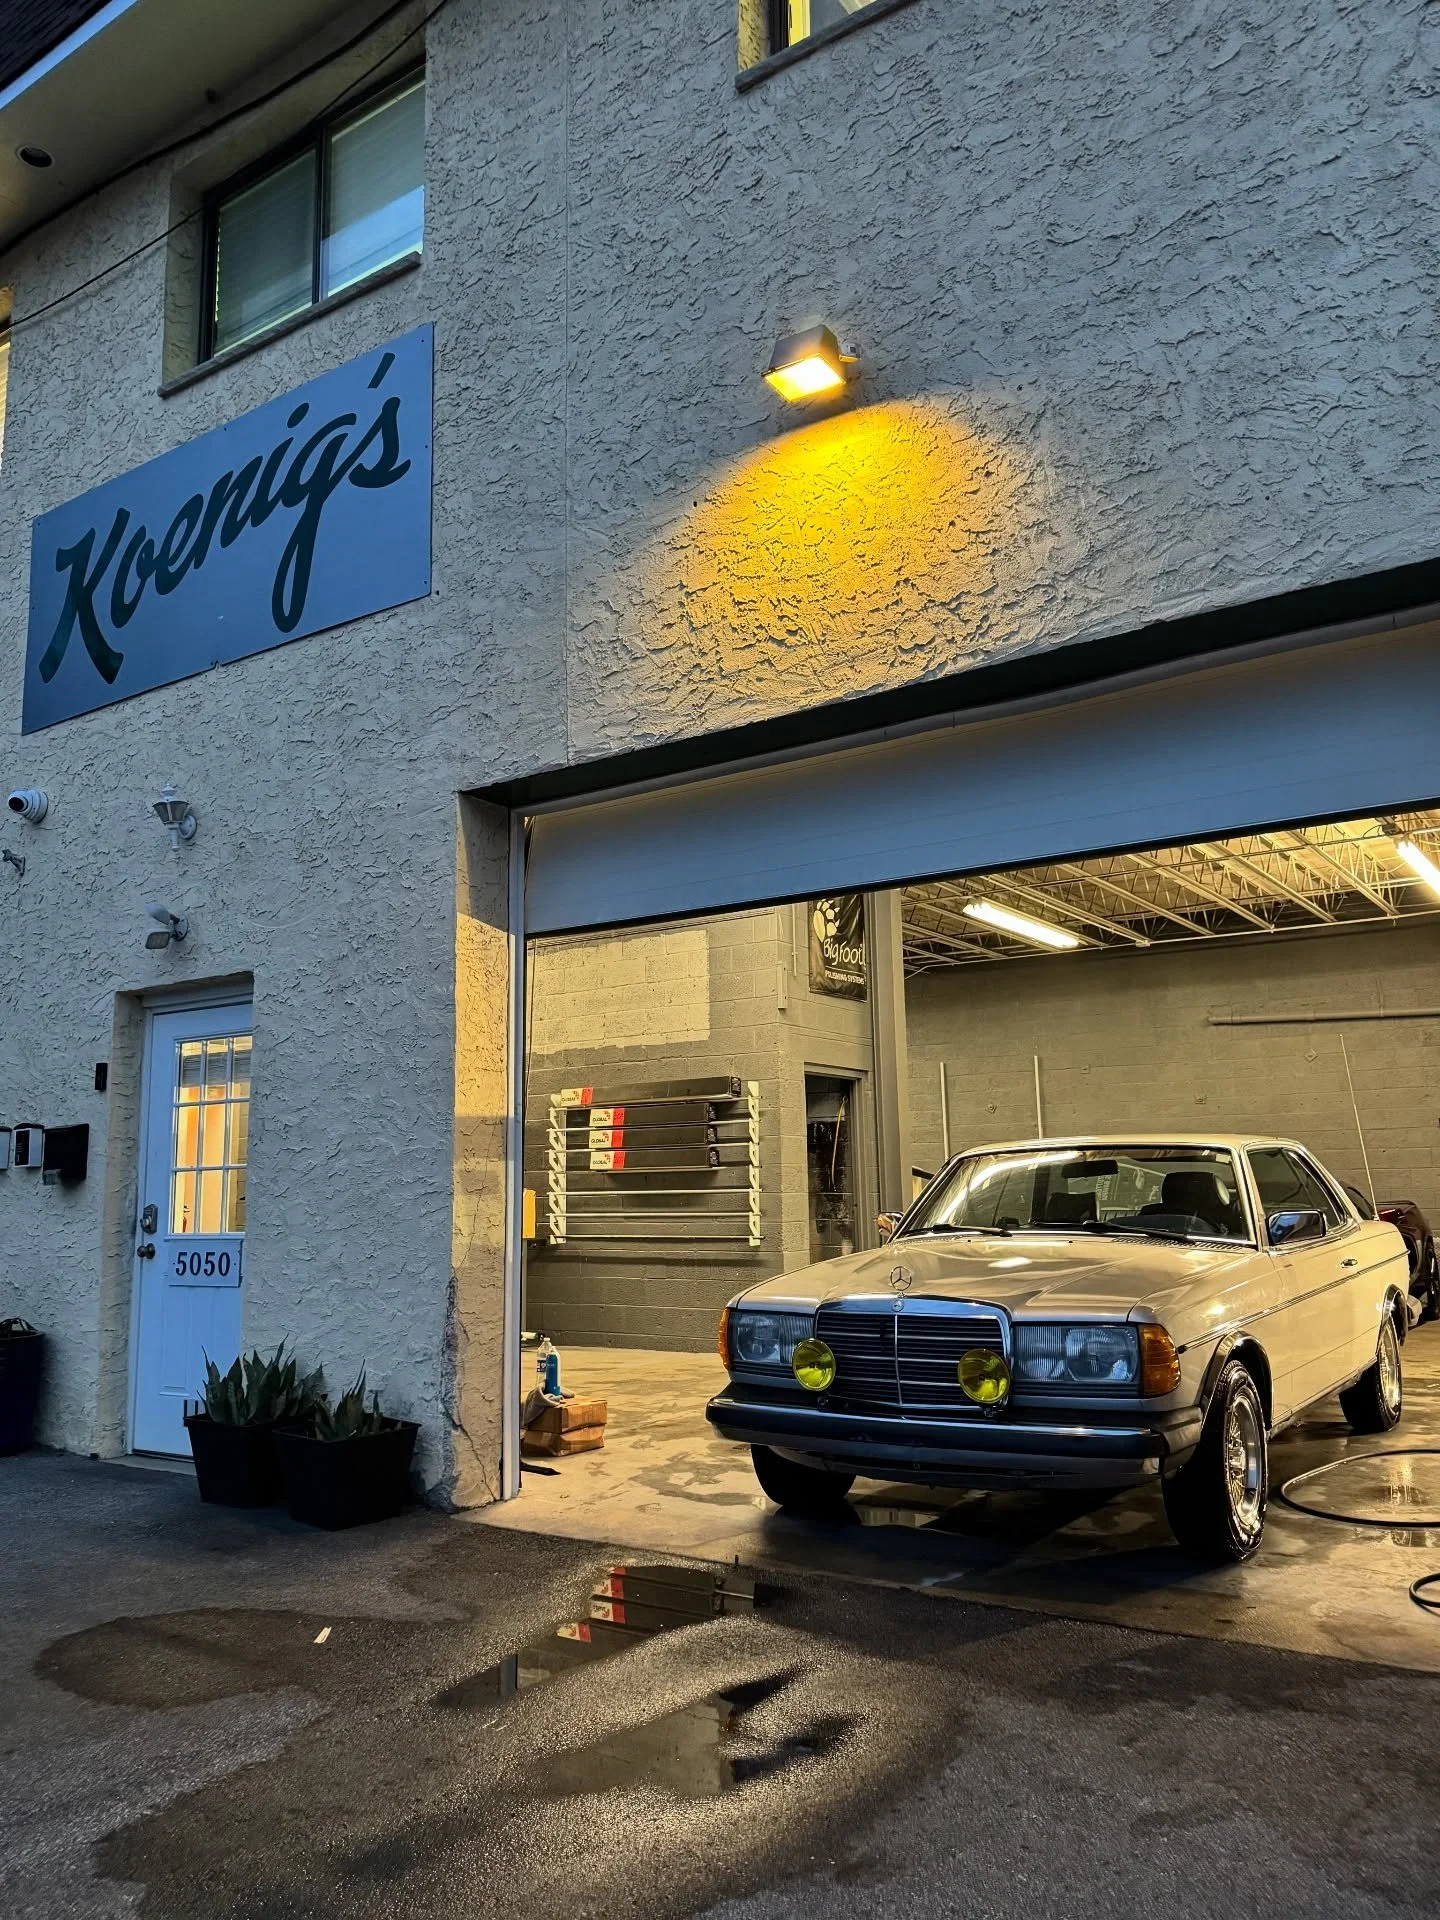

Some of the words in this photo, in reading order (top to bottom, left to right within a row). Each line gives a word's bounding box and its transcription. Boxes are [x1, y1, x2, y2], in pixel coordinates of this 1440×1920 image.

[38, 352, 412, 685] Koenig's
[825, 970, 848, 982] POLISHING
[847, 974, 865, 985] SYSTEMS
[175, 1251, 231, 1277] 5050
